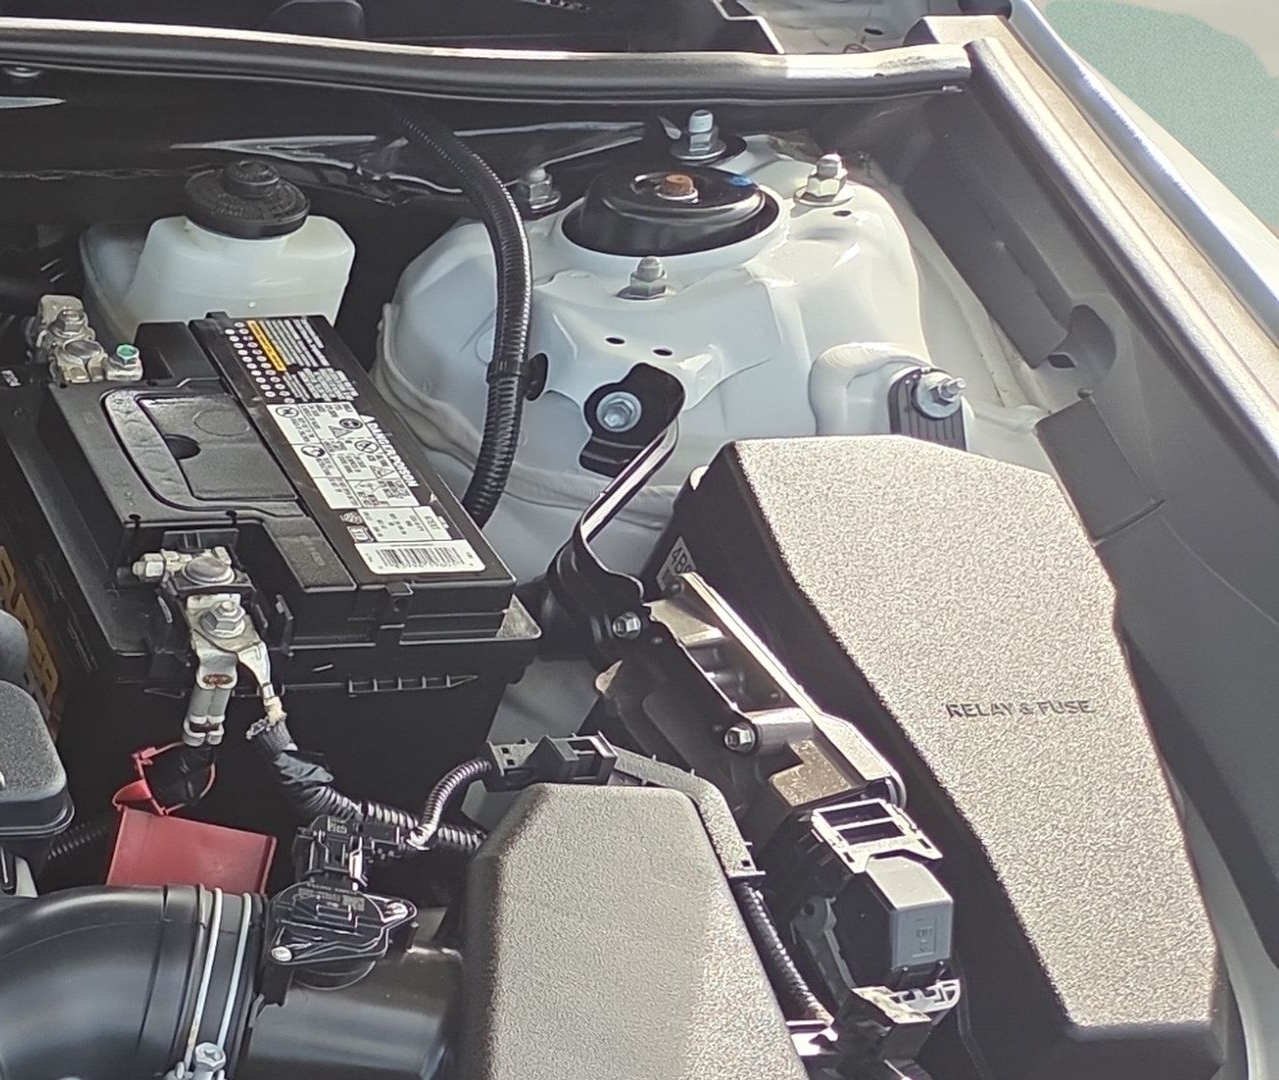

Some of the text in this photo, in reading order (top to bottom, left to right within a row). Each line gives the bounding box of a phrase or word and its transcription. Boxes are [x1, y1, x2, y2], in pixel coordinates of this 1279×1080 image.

[945, 700, 1095, 718] RELAY & FUSE
